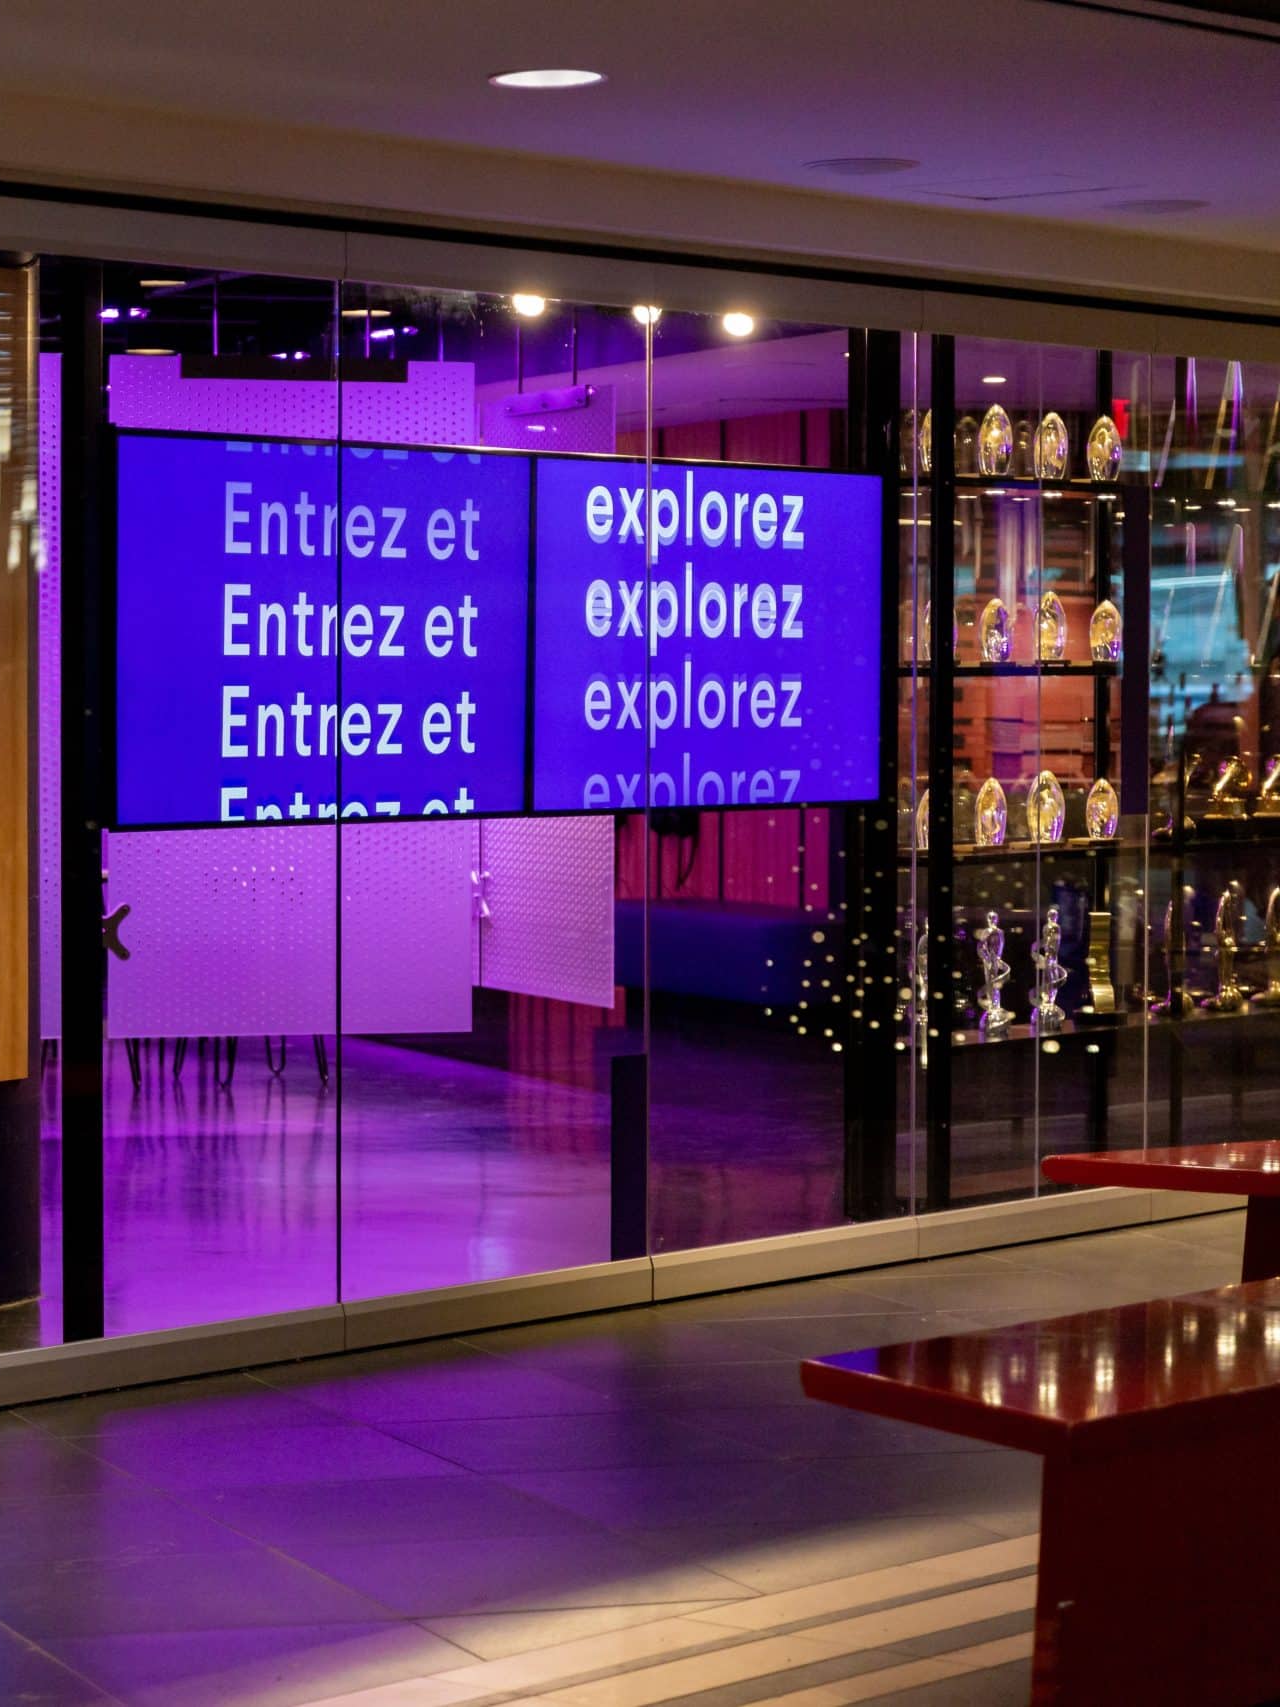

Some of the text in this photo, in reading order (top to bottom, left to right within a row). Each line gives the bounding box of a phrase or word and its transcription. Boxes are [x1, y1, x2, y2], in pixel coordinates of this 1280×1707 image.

[225, 481, 480, 560] Entrez et
[586, 470, 804, 564] explorez
[223, 583, 478, 657] Entrez et
[585, 562, 803, 656] explorez
[221, 685, 476, 758] Entrez et
[584, 660, 802, 748] explorez
